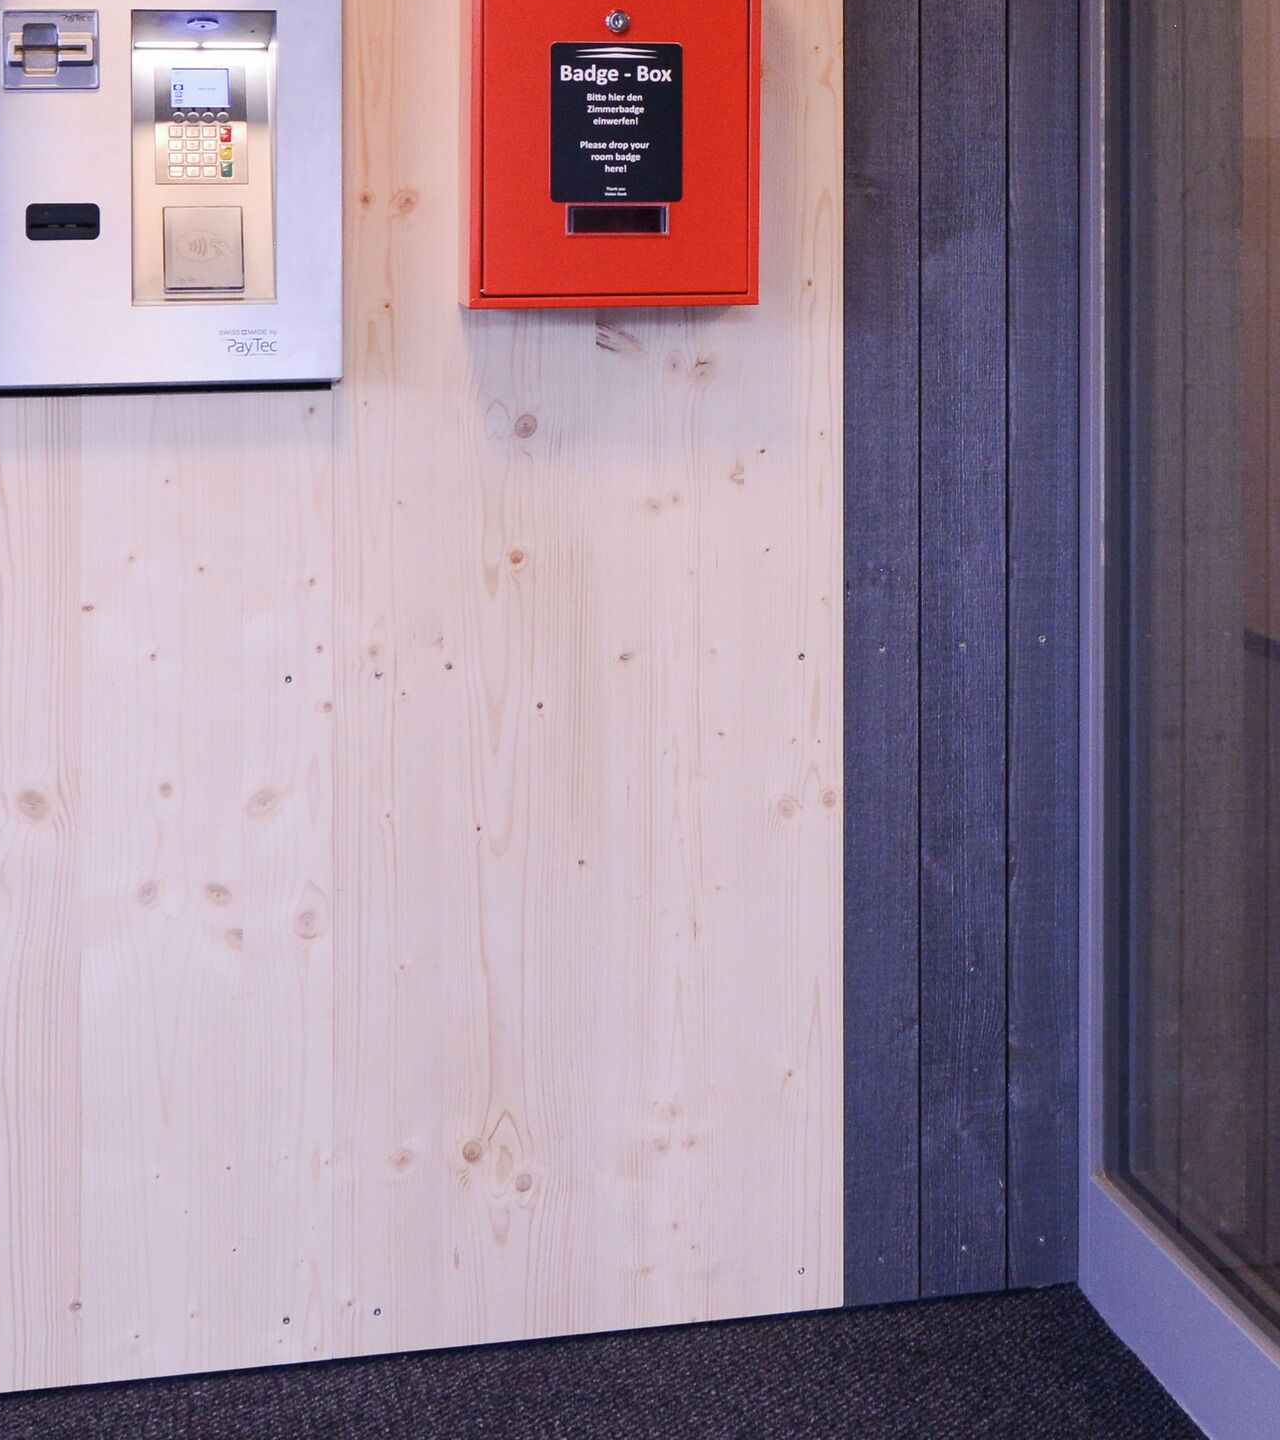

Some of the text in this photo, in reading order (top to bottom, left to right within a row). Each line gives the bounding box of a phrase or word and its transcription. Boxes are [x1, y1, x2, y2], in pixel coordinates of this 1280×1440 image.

[560, 64, 618, 85] Badge
[637, 66, 672, 82] Box
[586, 93, 643, 102] Bitte hier den
[587, 105, 644, 115] Zimmerbadge
[593, 117, 638, 125] einwerfen!
[580, 140, 650, 150] Please drop your
[615, 153, 641, 162] badge
[604, 164, 627, 173] here!
[227, 338, 278, 356] PayTec
